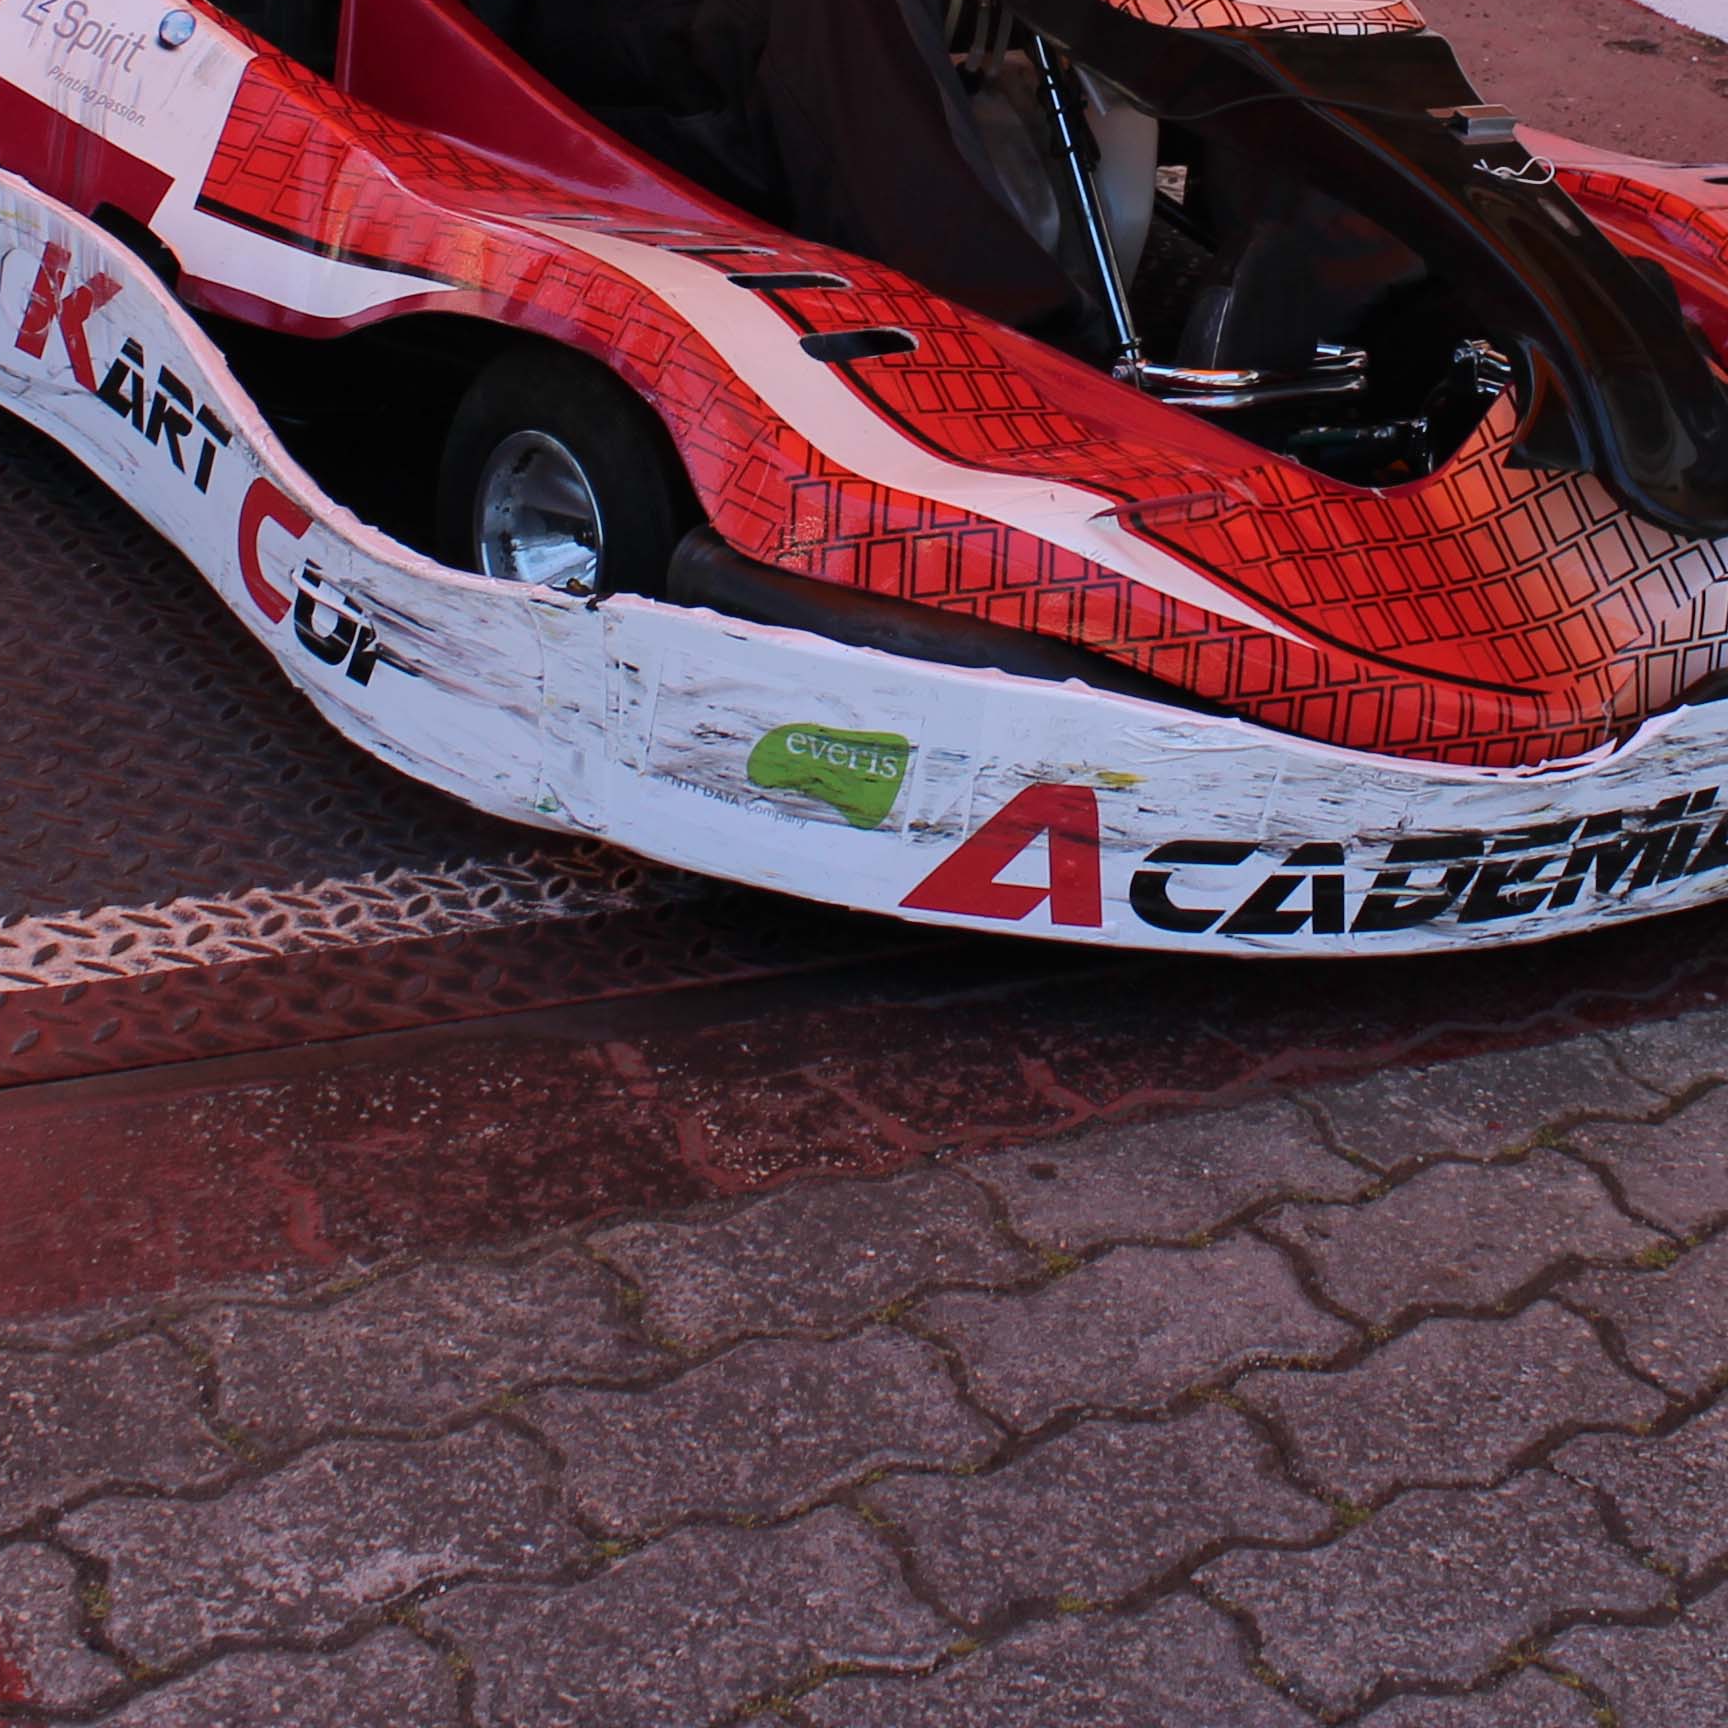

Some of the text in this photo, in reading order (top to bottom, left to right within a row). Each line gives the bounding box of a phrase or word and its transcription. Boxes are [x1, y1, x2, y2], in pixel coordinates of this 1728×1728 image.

[53, 0, 147, 73] Spirit
[48, 65, 97, 104] Printing
[14, 240, 233, 495] KART
[786, 731, 899, 779] everis
[743, 795, 810, 830] Company
